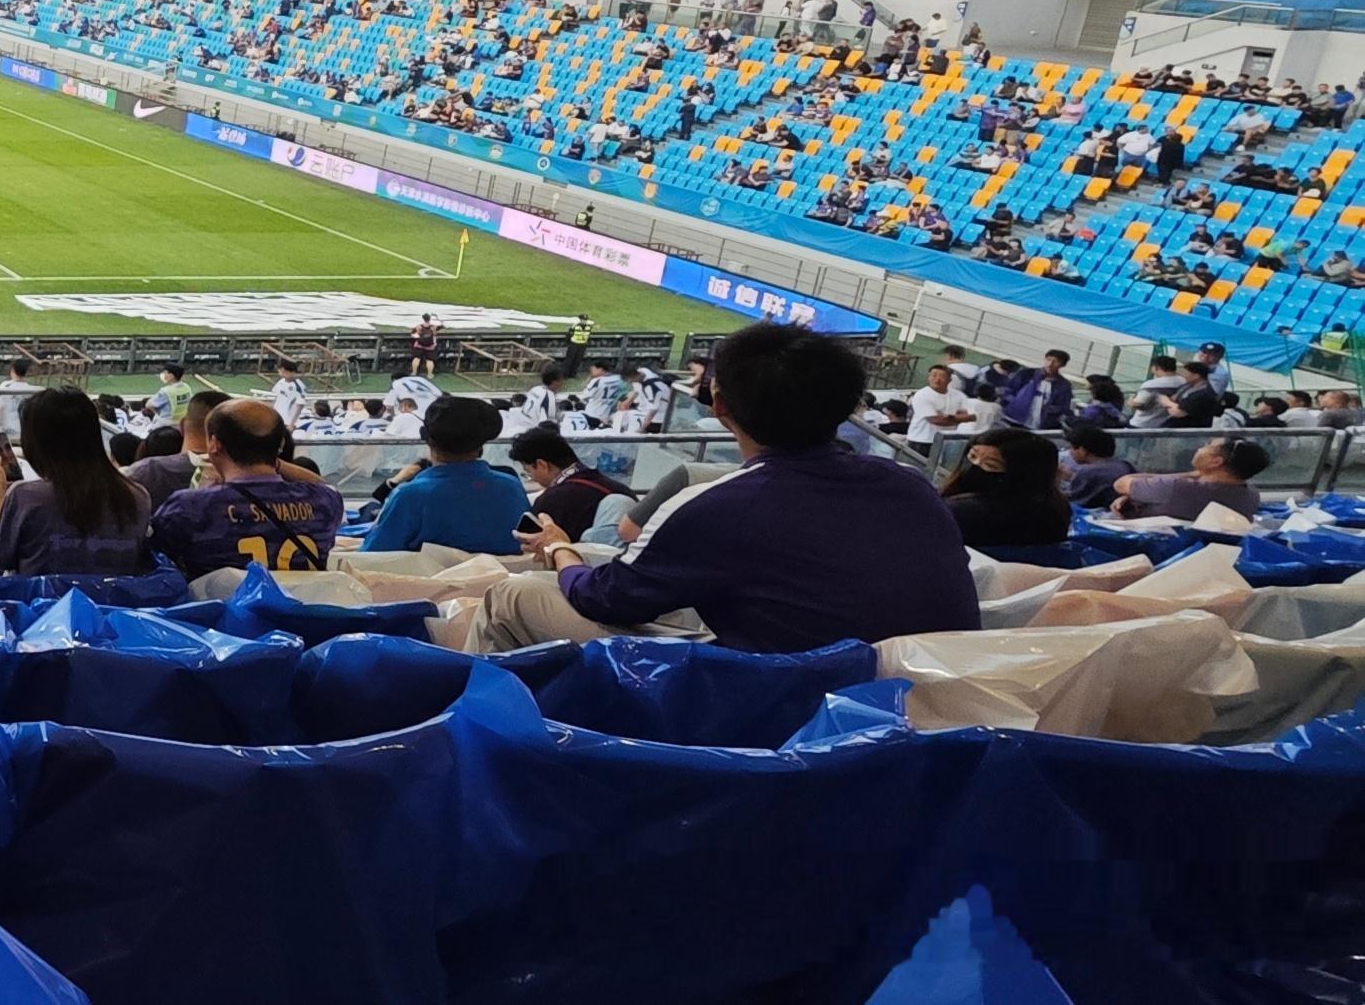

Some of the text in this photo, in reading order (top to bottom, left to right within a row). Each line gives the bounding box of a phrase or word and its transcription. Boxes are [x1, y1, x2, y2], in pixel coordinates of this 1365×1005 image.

[553, 232, 631, 268] 中国体育彩票
[707, 276, 817, 326] 诚信联赛
[249, 501, 316, 523] SAVADOR
